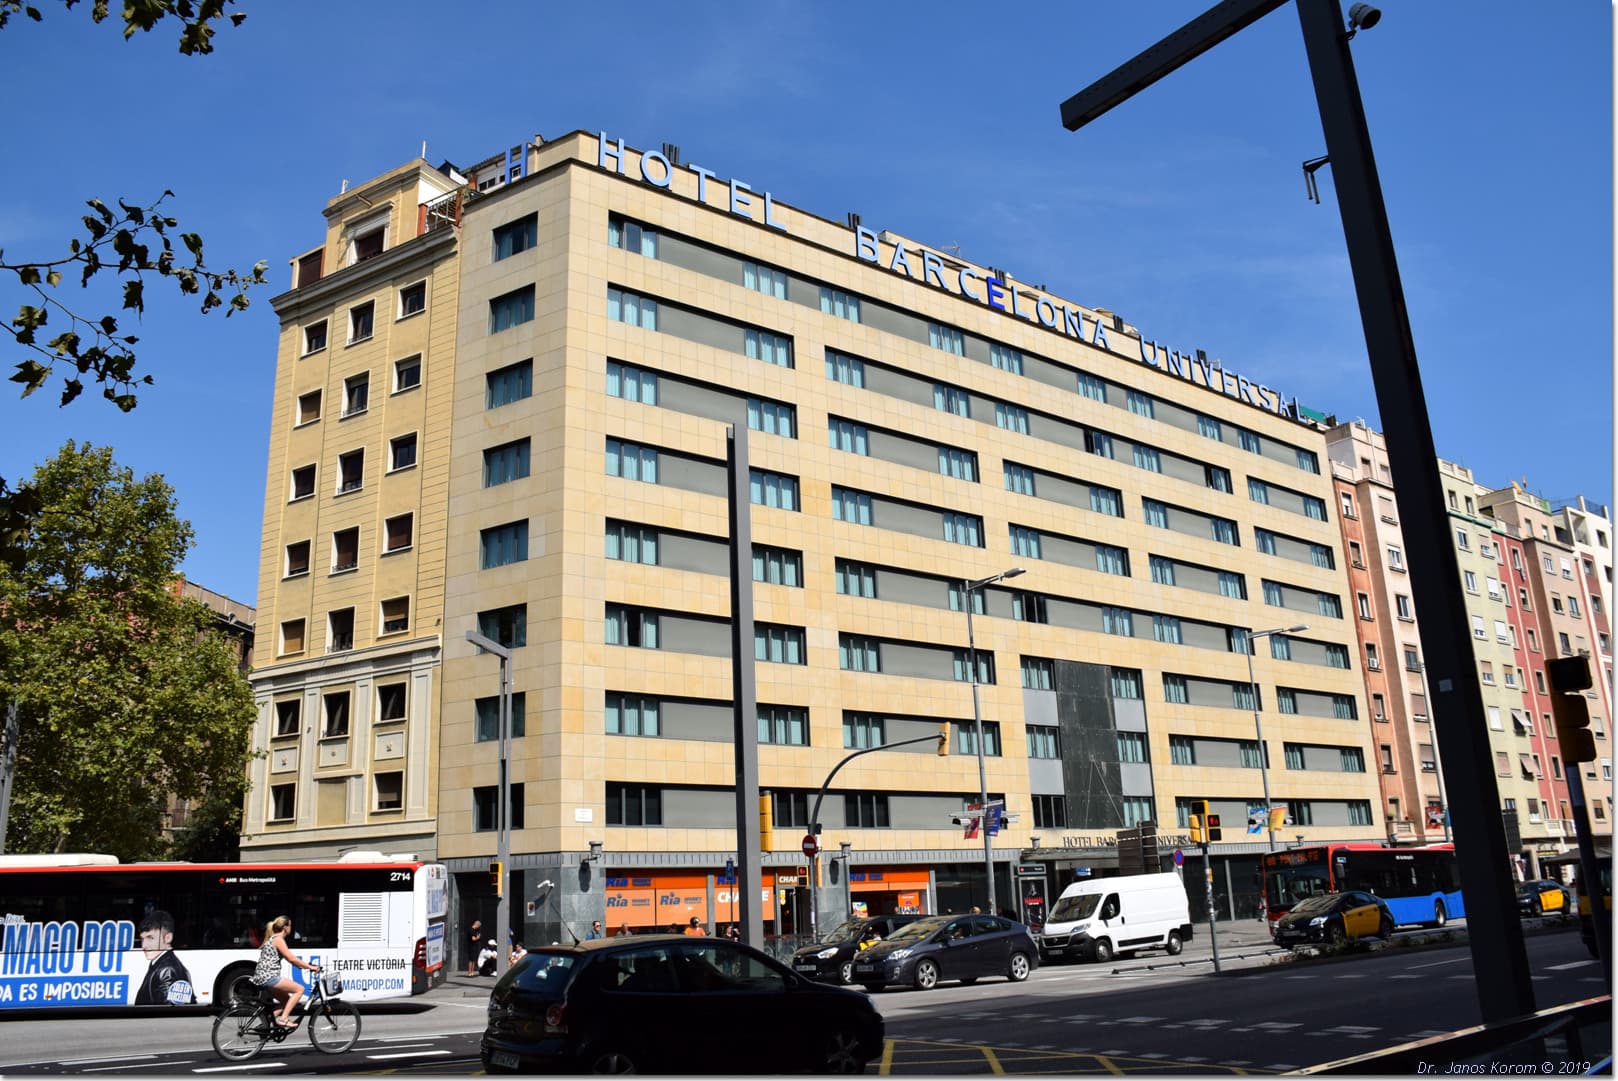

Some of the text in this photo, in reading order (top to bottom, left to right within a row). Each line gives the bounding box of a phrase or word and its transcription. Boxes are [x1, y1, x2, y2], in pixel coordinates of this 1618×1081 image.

[598, 131, 1308, 424] HOTEL BARCELONA UNIVERSAL
[1063, 836, 1092, 848] HOTEL
[390, 872, 410, 881] 2714
[607, 892, 628, 907] Ria
[660, 891, 680, 905] Ria
[3, 920, 134, 975] MAGO POP
[332, 960, 364, 971] TEATRE
[19, 983, 38, 1002] ES
[43, 981, 123, 1001] IMPOSIBLE
[331, 978, 404, 991] EMAGOPOP.COM
